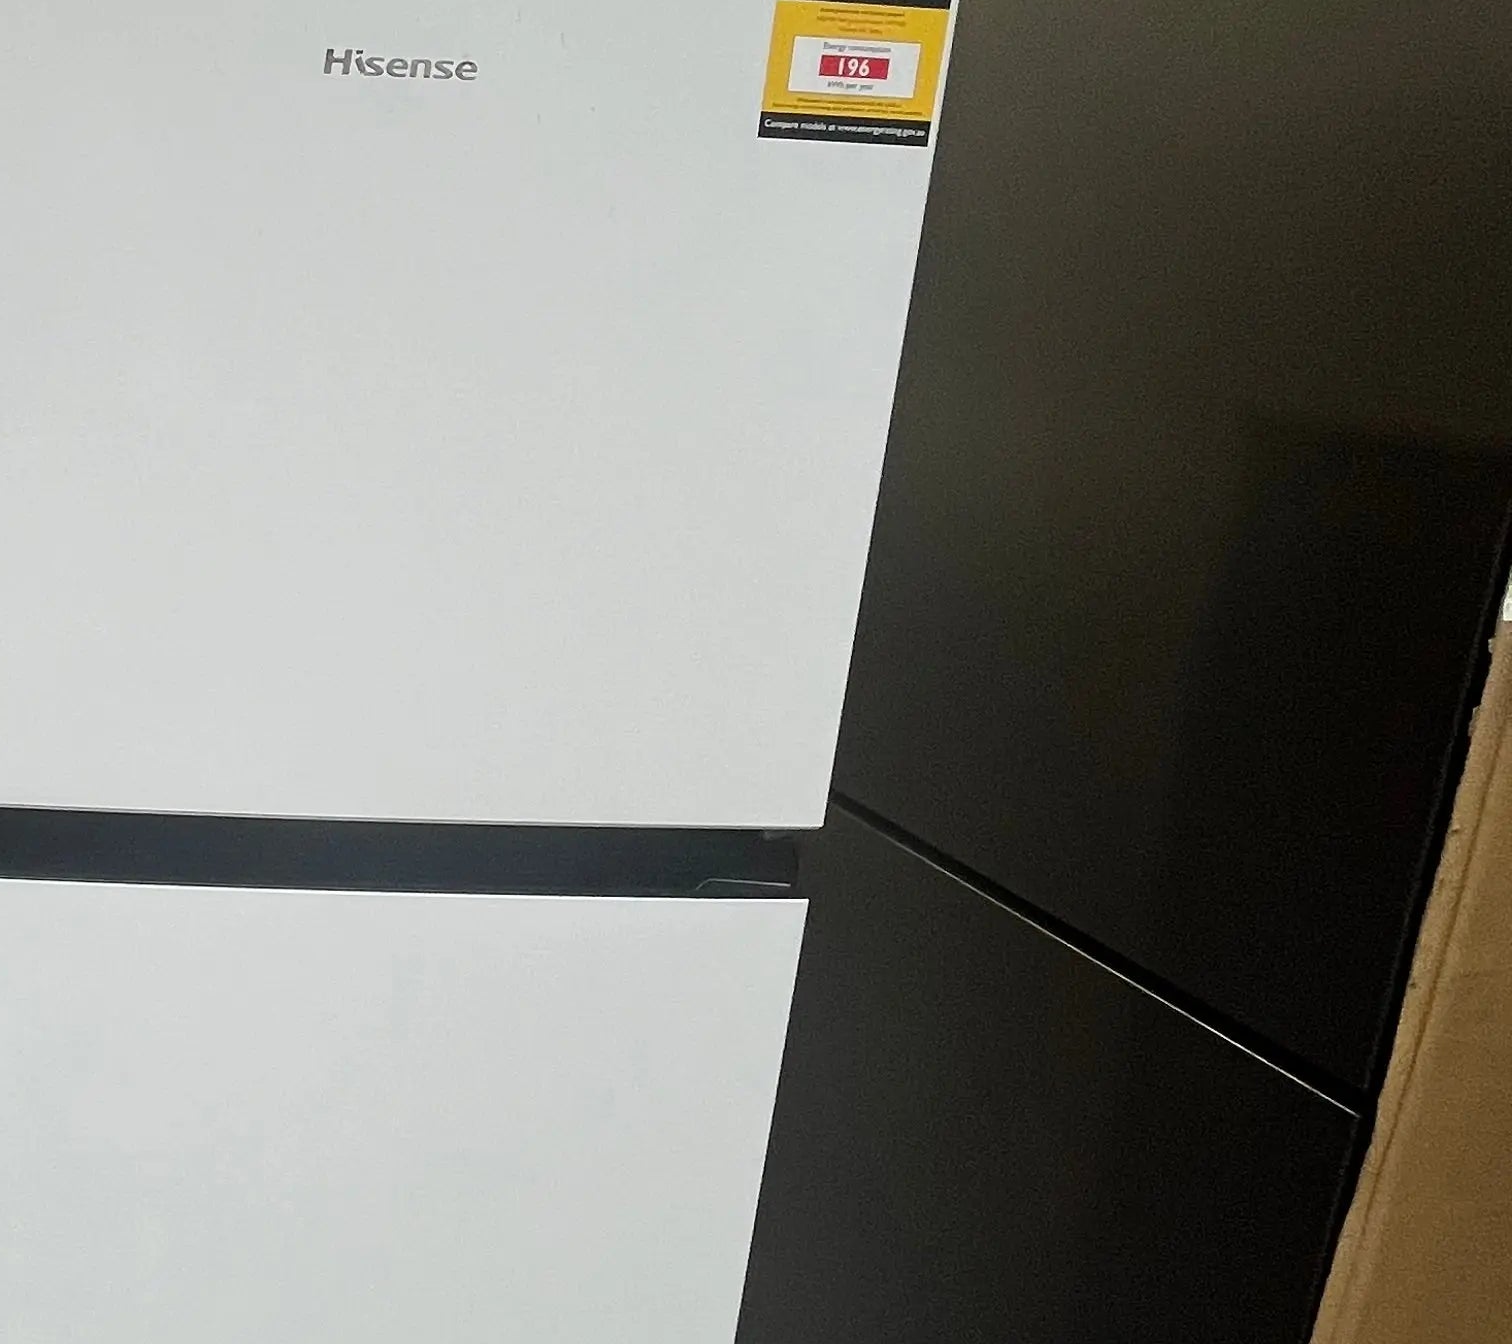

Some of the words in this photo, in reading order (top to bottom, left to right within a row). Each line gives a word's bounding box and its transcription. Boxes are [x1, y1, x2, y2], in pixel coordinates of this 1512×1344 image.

[323, 48, 479, 81] Hisense
[838, 57, 871, 78] 196
[764, 117, 799, 131] Compare
